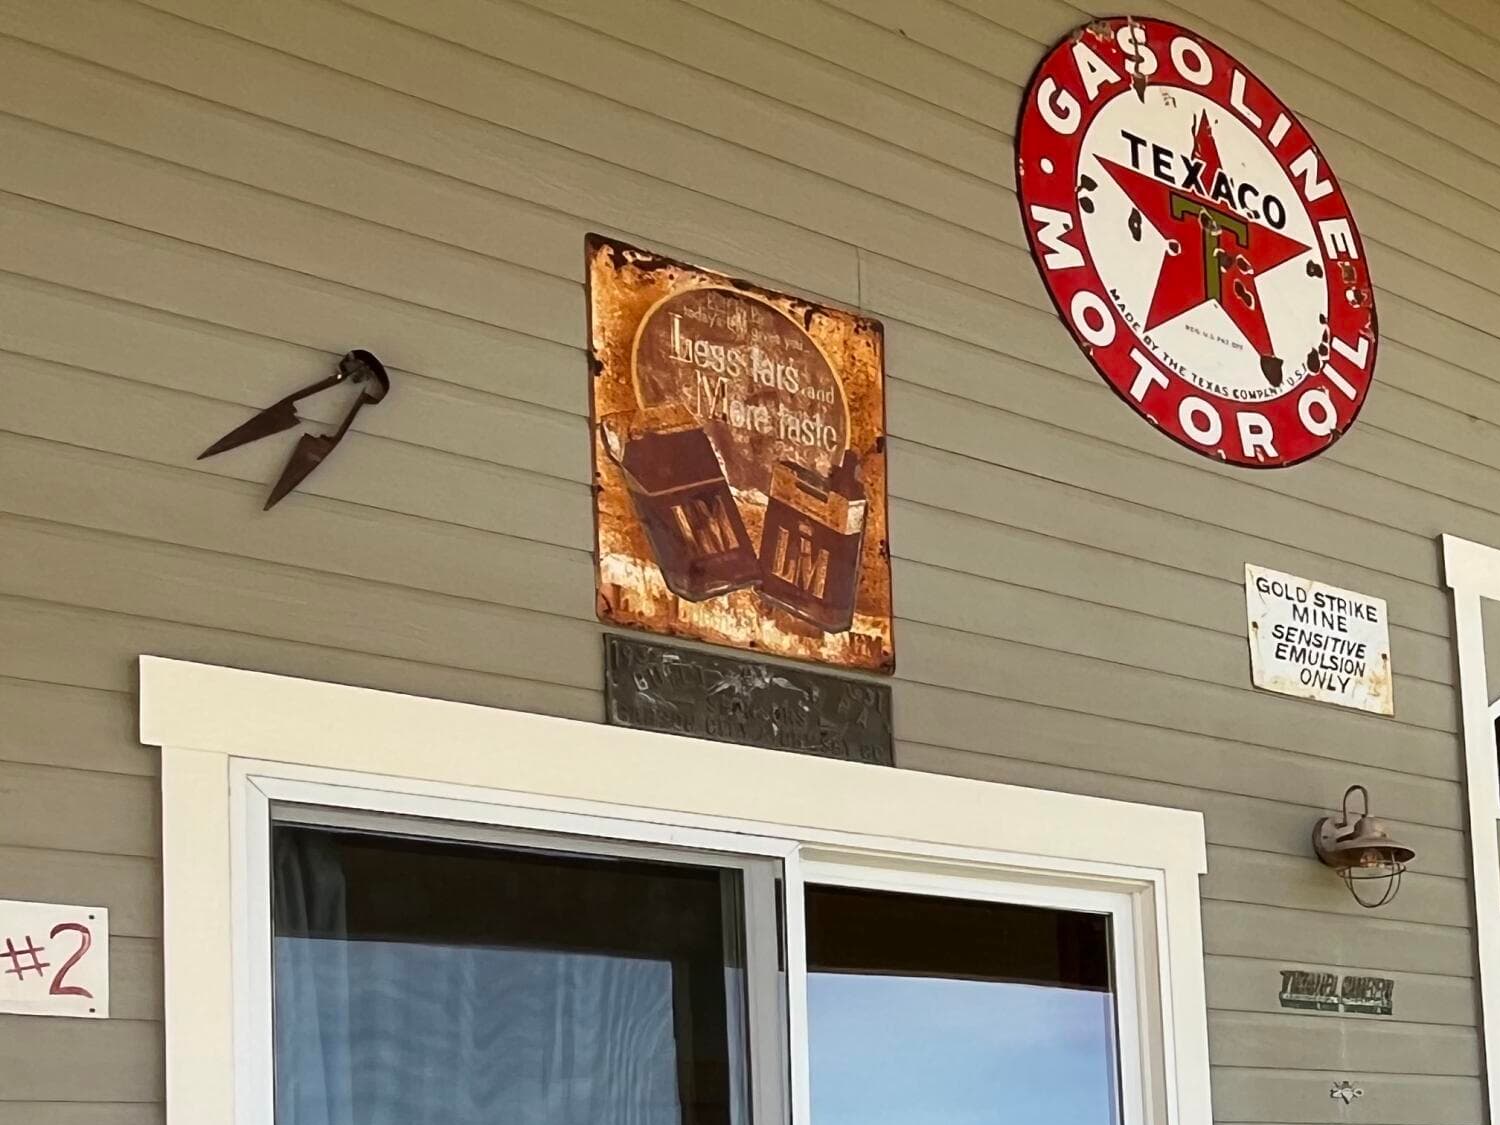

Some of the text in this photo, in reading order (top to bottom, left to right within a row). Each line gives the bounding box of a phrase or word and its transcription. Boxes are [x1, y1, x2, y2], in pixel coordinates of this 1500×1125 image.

[1037, 26, 1359, 261] GASOLINE
[1120, 130, 1287, 230] TEXACO
[1030, 204, 1371, 458] MOTOR OIL
[1109, 288, 1141, 333] MADE
[1163, 351, 1187, 377] THE
[1191, 372, 1229, 397] TEXAS
[1256, 576, 1378, 623] GOLD STRIKE
[1292, 603, 1348, 633] MINE
[1271, 624, 1367, 659] SENSITIVE
[1275, 642, 1366, 678] EMULSION
[1300, 668, 1351, 694] ONLY
[0, 922, 94, 999] #2
